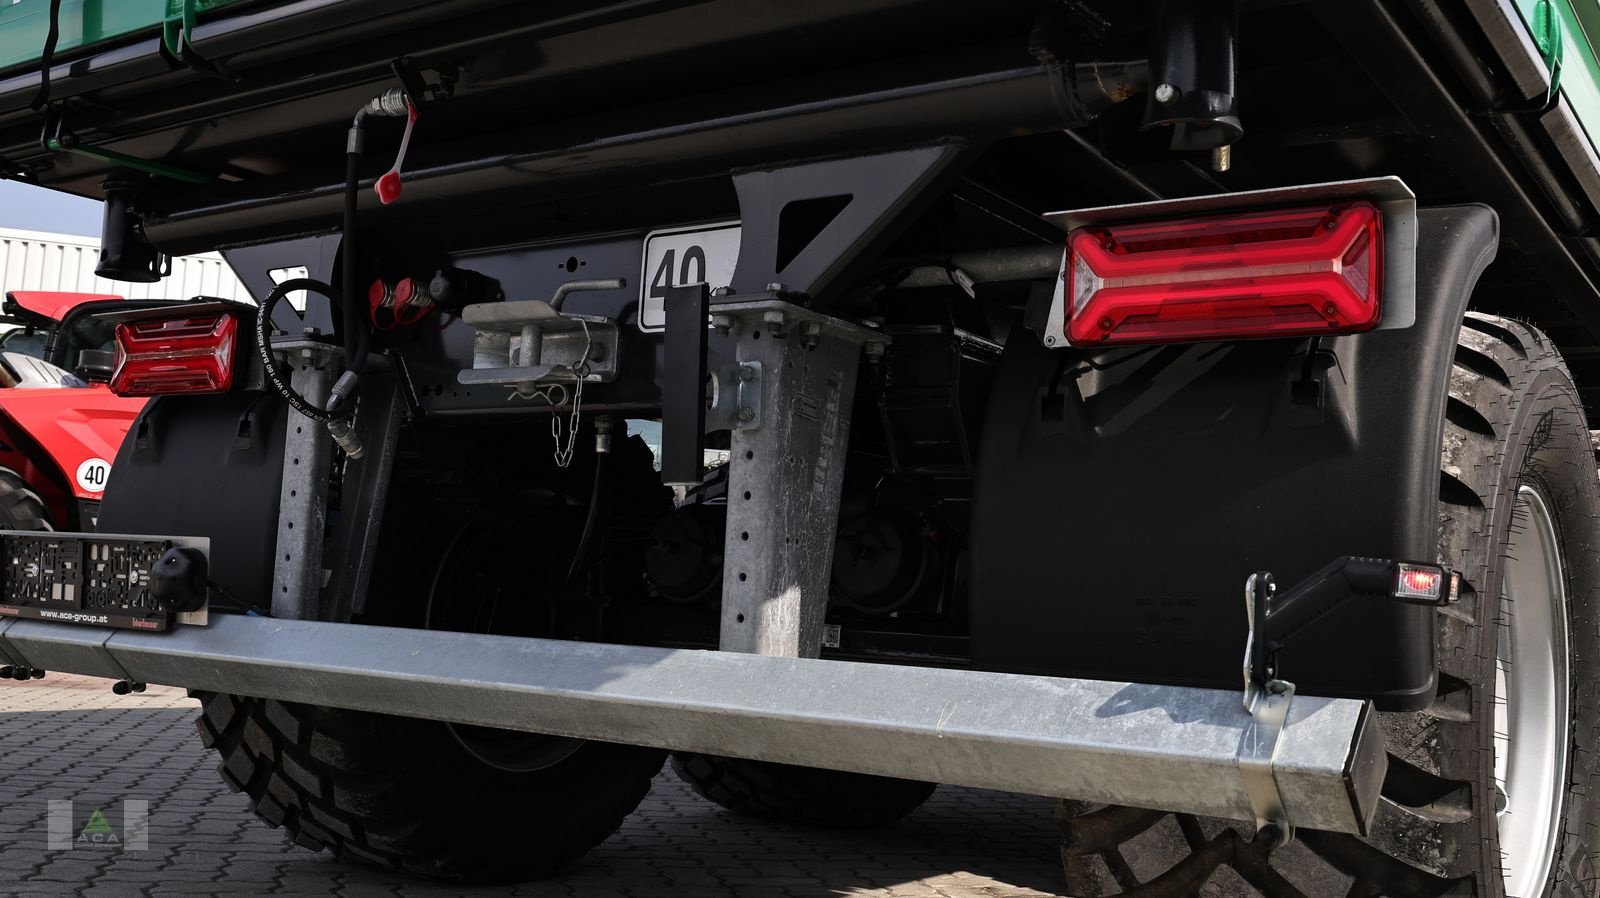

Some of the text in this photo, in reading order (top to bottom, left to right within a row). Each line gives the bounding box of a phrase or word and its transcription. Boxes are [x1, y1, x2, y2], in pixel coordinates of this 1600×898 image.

[650, 245, 706, 311] 40
[259, 347, 270, 363] BAR
[272, 377, 283, 390] WP
[281, 388, 290, 398] 10
[85, 465, 105, 485] 40
[40, 610, 108, 624] www.aca-group.at
